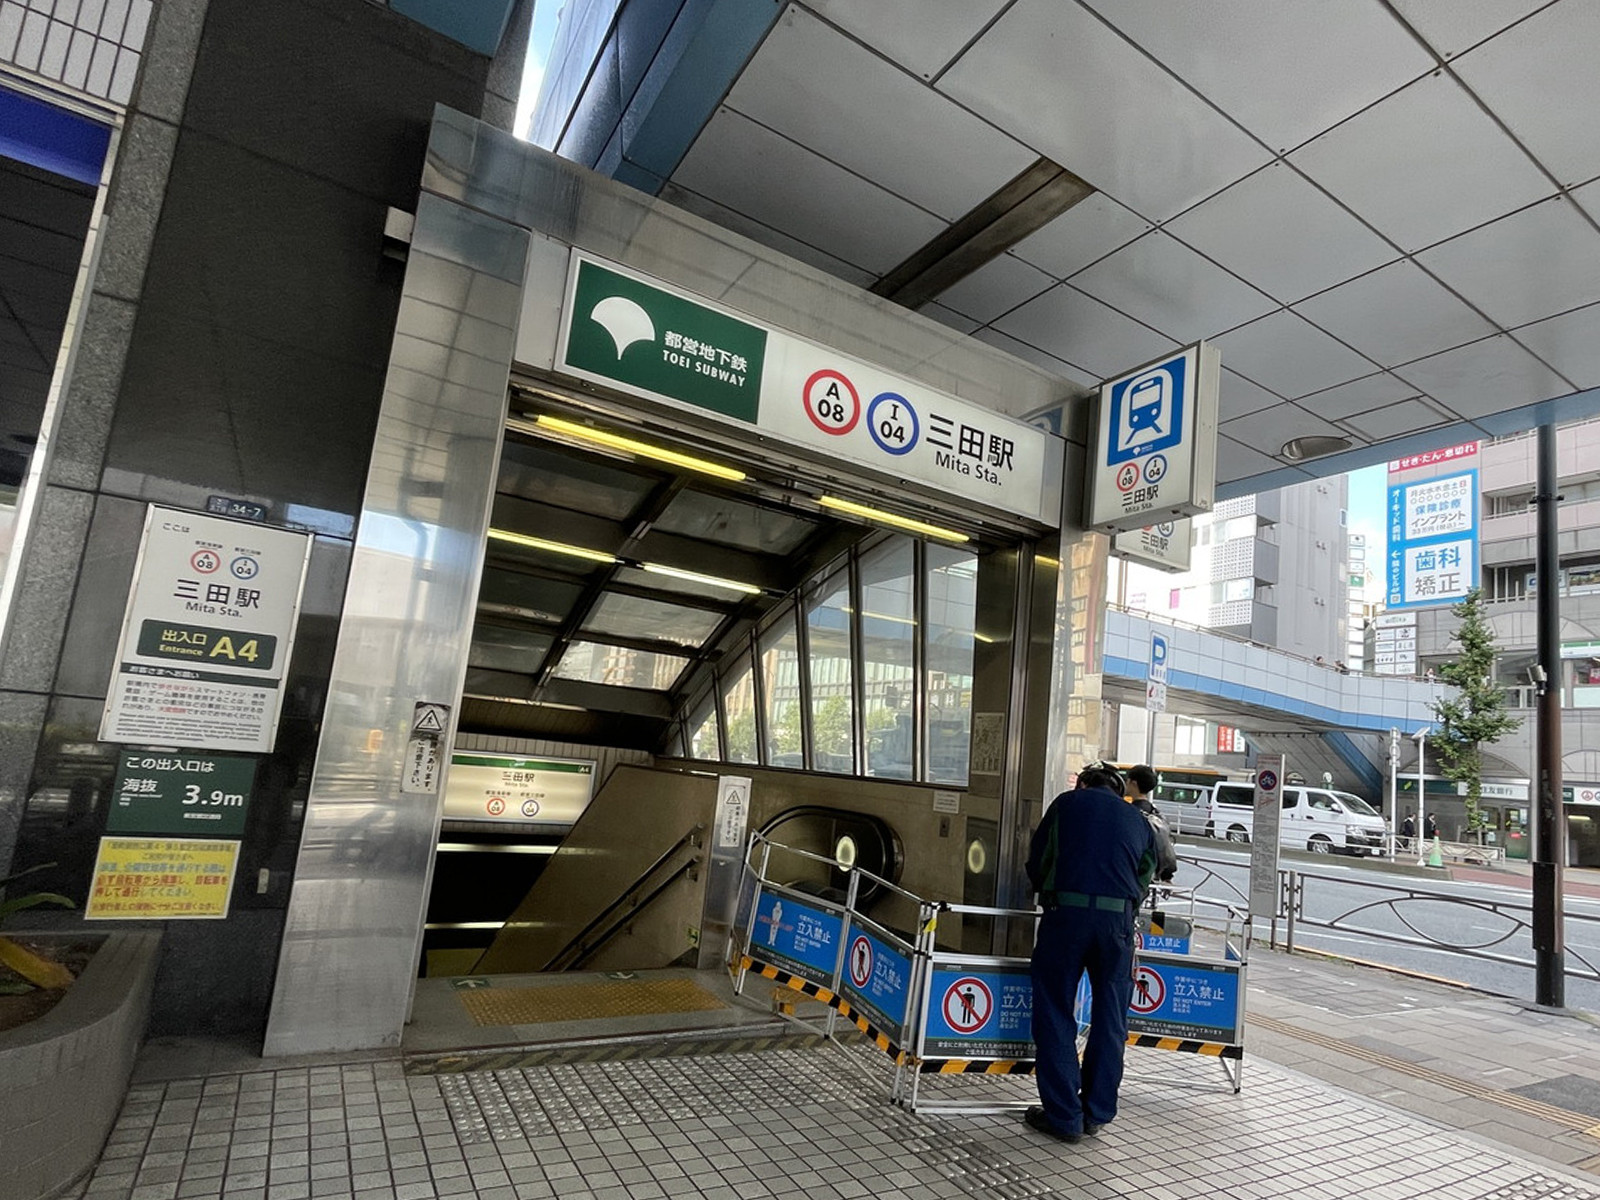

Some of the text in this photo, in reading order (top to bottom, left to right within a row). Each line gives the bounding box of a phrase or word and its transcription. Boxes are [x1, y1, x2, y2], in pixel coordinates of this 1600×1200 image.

[664, 330, 748, 373] 都営地下鉄
[663, 350, 746, 388] TOEI SUBWAY
[826, 382, 841, 401] A
[817, 399, 845, 424] 08
[890, 403, 899, 421] I
[880, 420, 905, 444] 04
[926, 413, 1015, 472] 三田駅
[935, 450, 1003, 486] Mita Sta.
[1149, 468, 1160, 478] 04
[1122, 476, 1133, 486] 08
[1122, 485, 1158, 507] 三田駅
[232, 504, 261, 518] 34-7
[1125, 505, 1139, 513] Mita
[1416, 498, 1461, 515] 保険診療
[162, 522, 190, 533] ここは
[1411, 510, 1466, 527] インプラント
[1141, 531, 1168, 550] 三田駅
[197, 560, 213, 569] 08
[1415, 546, 1461, 572] 歯科
[236, 566, 252, 575] 04
[1415, 572, 1461, 596] 矯正
[173, 578, 261, 610] 三田駅
[185, 601, 243, 618] Mita Sta.
[161, 629, 207, 646] 出入口
[159, 643, 204, 657] Entrance
[209, 636, 259, 662] A4
[1151, 635, 1166, 676] P
[126, 756, 215, 773] この出入口は
[121, 778, 158, 793] 海抜
[502, 771, 535, 782] 三田駅
[181, 784, 244, 806] 3.9m
[797, 921, 831, 944] 立入禁止
[1148, 936, 1181, 948] 立入禁止
[875, 961, 901, 990] 立入禁止
[1001, 993, 1033, 1009] 立入
[1173, 983, 1225, 1001] 立入禁止
